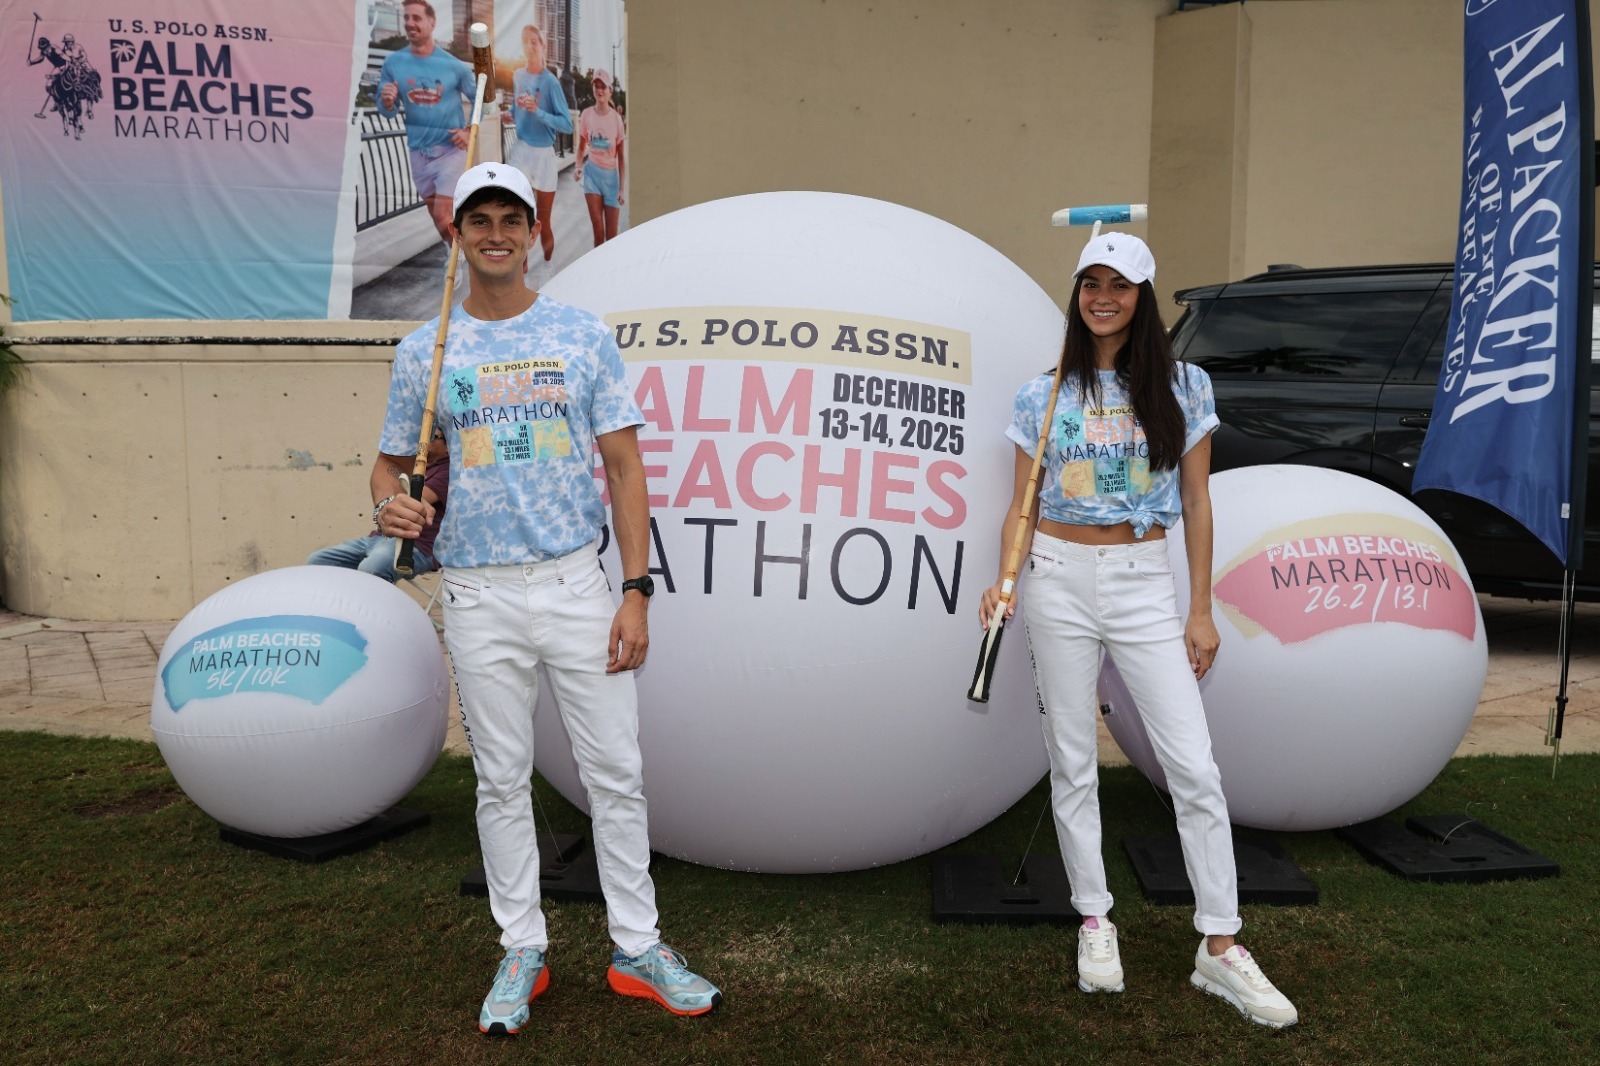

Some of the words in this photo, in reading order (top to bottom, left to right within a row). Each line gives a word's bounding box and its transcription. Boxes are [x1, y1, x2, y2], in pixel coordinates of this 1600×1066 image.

[155, 21, 207, 37] POLO
[214, 24, 273, 42] ASSN.
[109, 39, 233, 78] PALM
[112, 77, 314, 119] BEACHES
[114, 114, 290, 144] MARATHON
[1465, 104, 1483, 213] PALM
[1480, 162, 1502, 213] OF
[701, 319, 819, 349] POLO
[831, 324, 960, 369] ASSN.
[479, 371, 532, 390] PALM
[505, 363, 530, 372] POLO
[533, 361, 562, 369] ASSN.
[480, 385, 568, 407] BEACHES
[633, 365, 814, 436] ALM
[833, 373, 965, 419] DECEMBER
[453, 402, 567, 430] MARATHON
[1110, 408, 1134, 416] POLO
[819, 408, 893, 447] 13-14,
[900, 417, 964, 455] 2025
[1265, 537, 1340, 562] PALM
[1343, 536, 1442, 563] BEACHES
[1271, 558, 1451, 591] MARATHON
[192, 636, 234, 654] PALM
[236, 633, 321, 648] BEACHES
[190, 648, 320, 673] MARATHON
